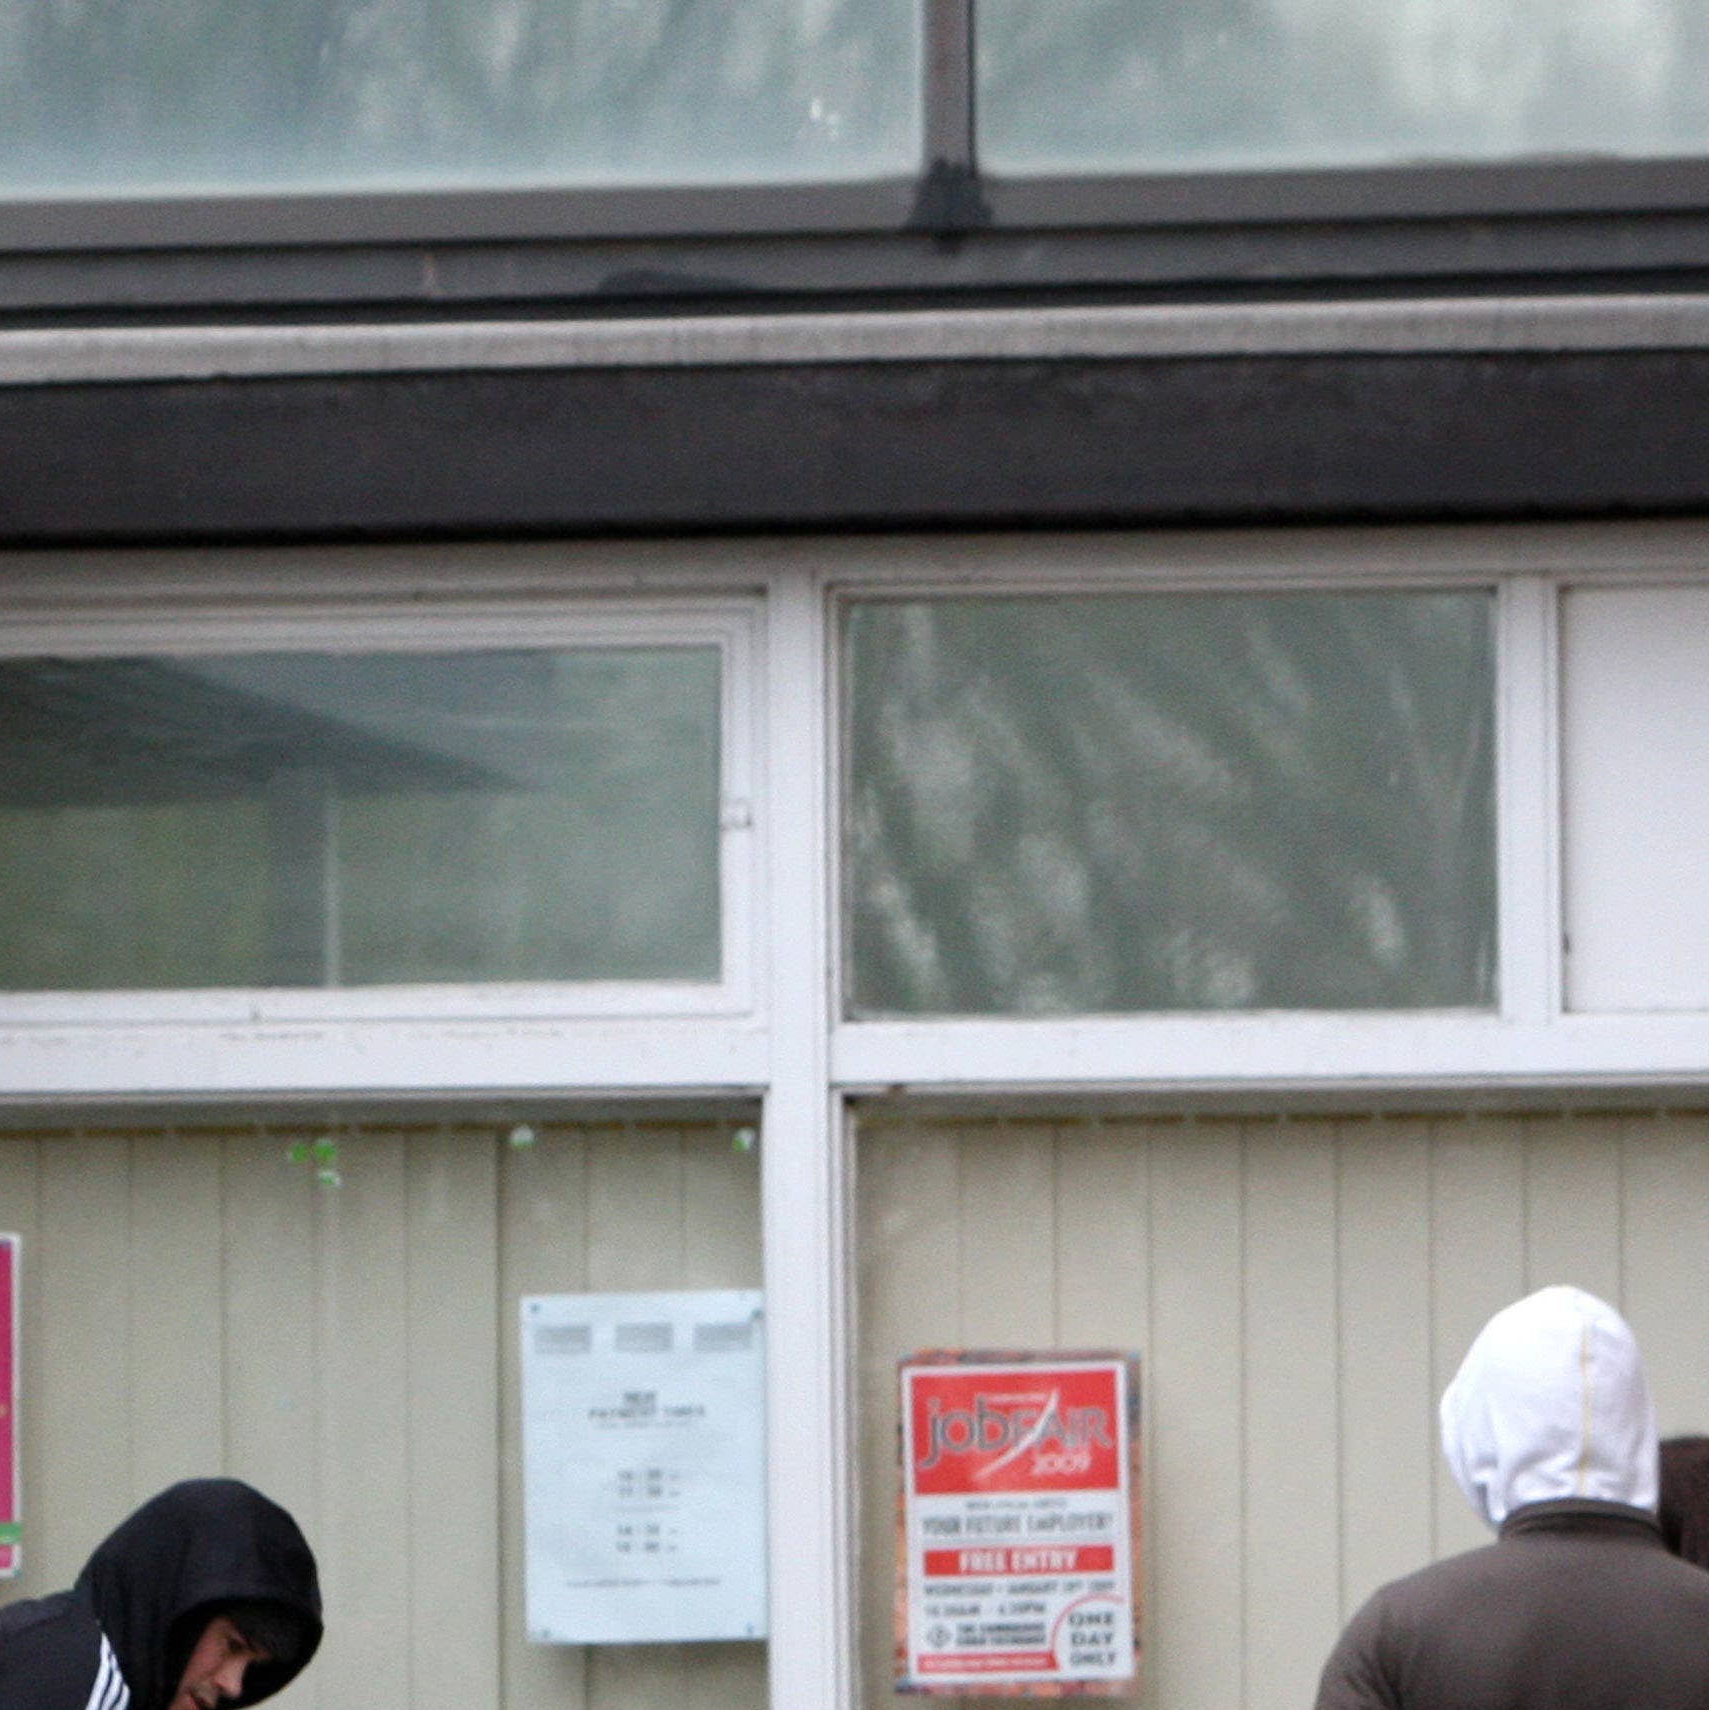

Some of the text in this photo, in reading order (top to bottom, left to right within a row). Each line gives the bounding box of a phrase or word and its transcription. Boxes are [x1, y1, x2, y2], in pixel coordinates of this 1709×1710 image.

[958, 1548, 1079, 1572] FREE ENTRY
[1071, 1631, 1114, 1646] DAY
